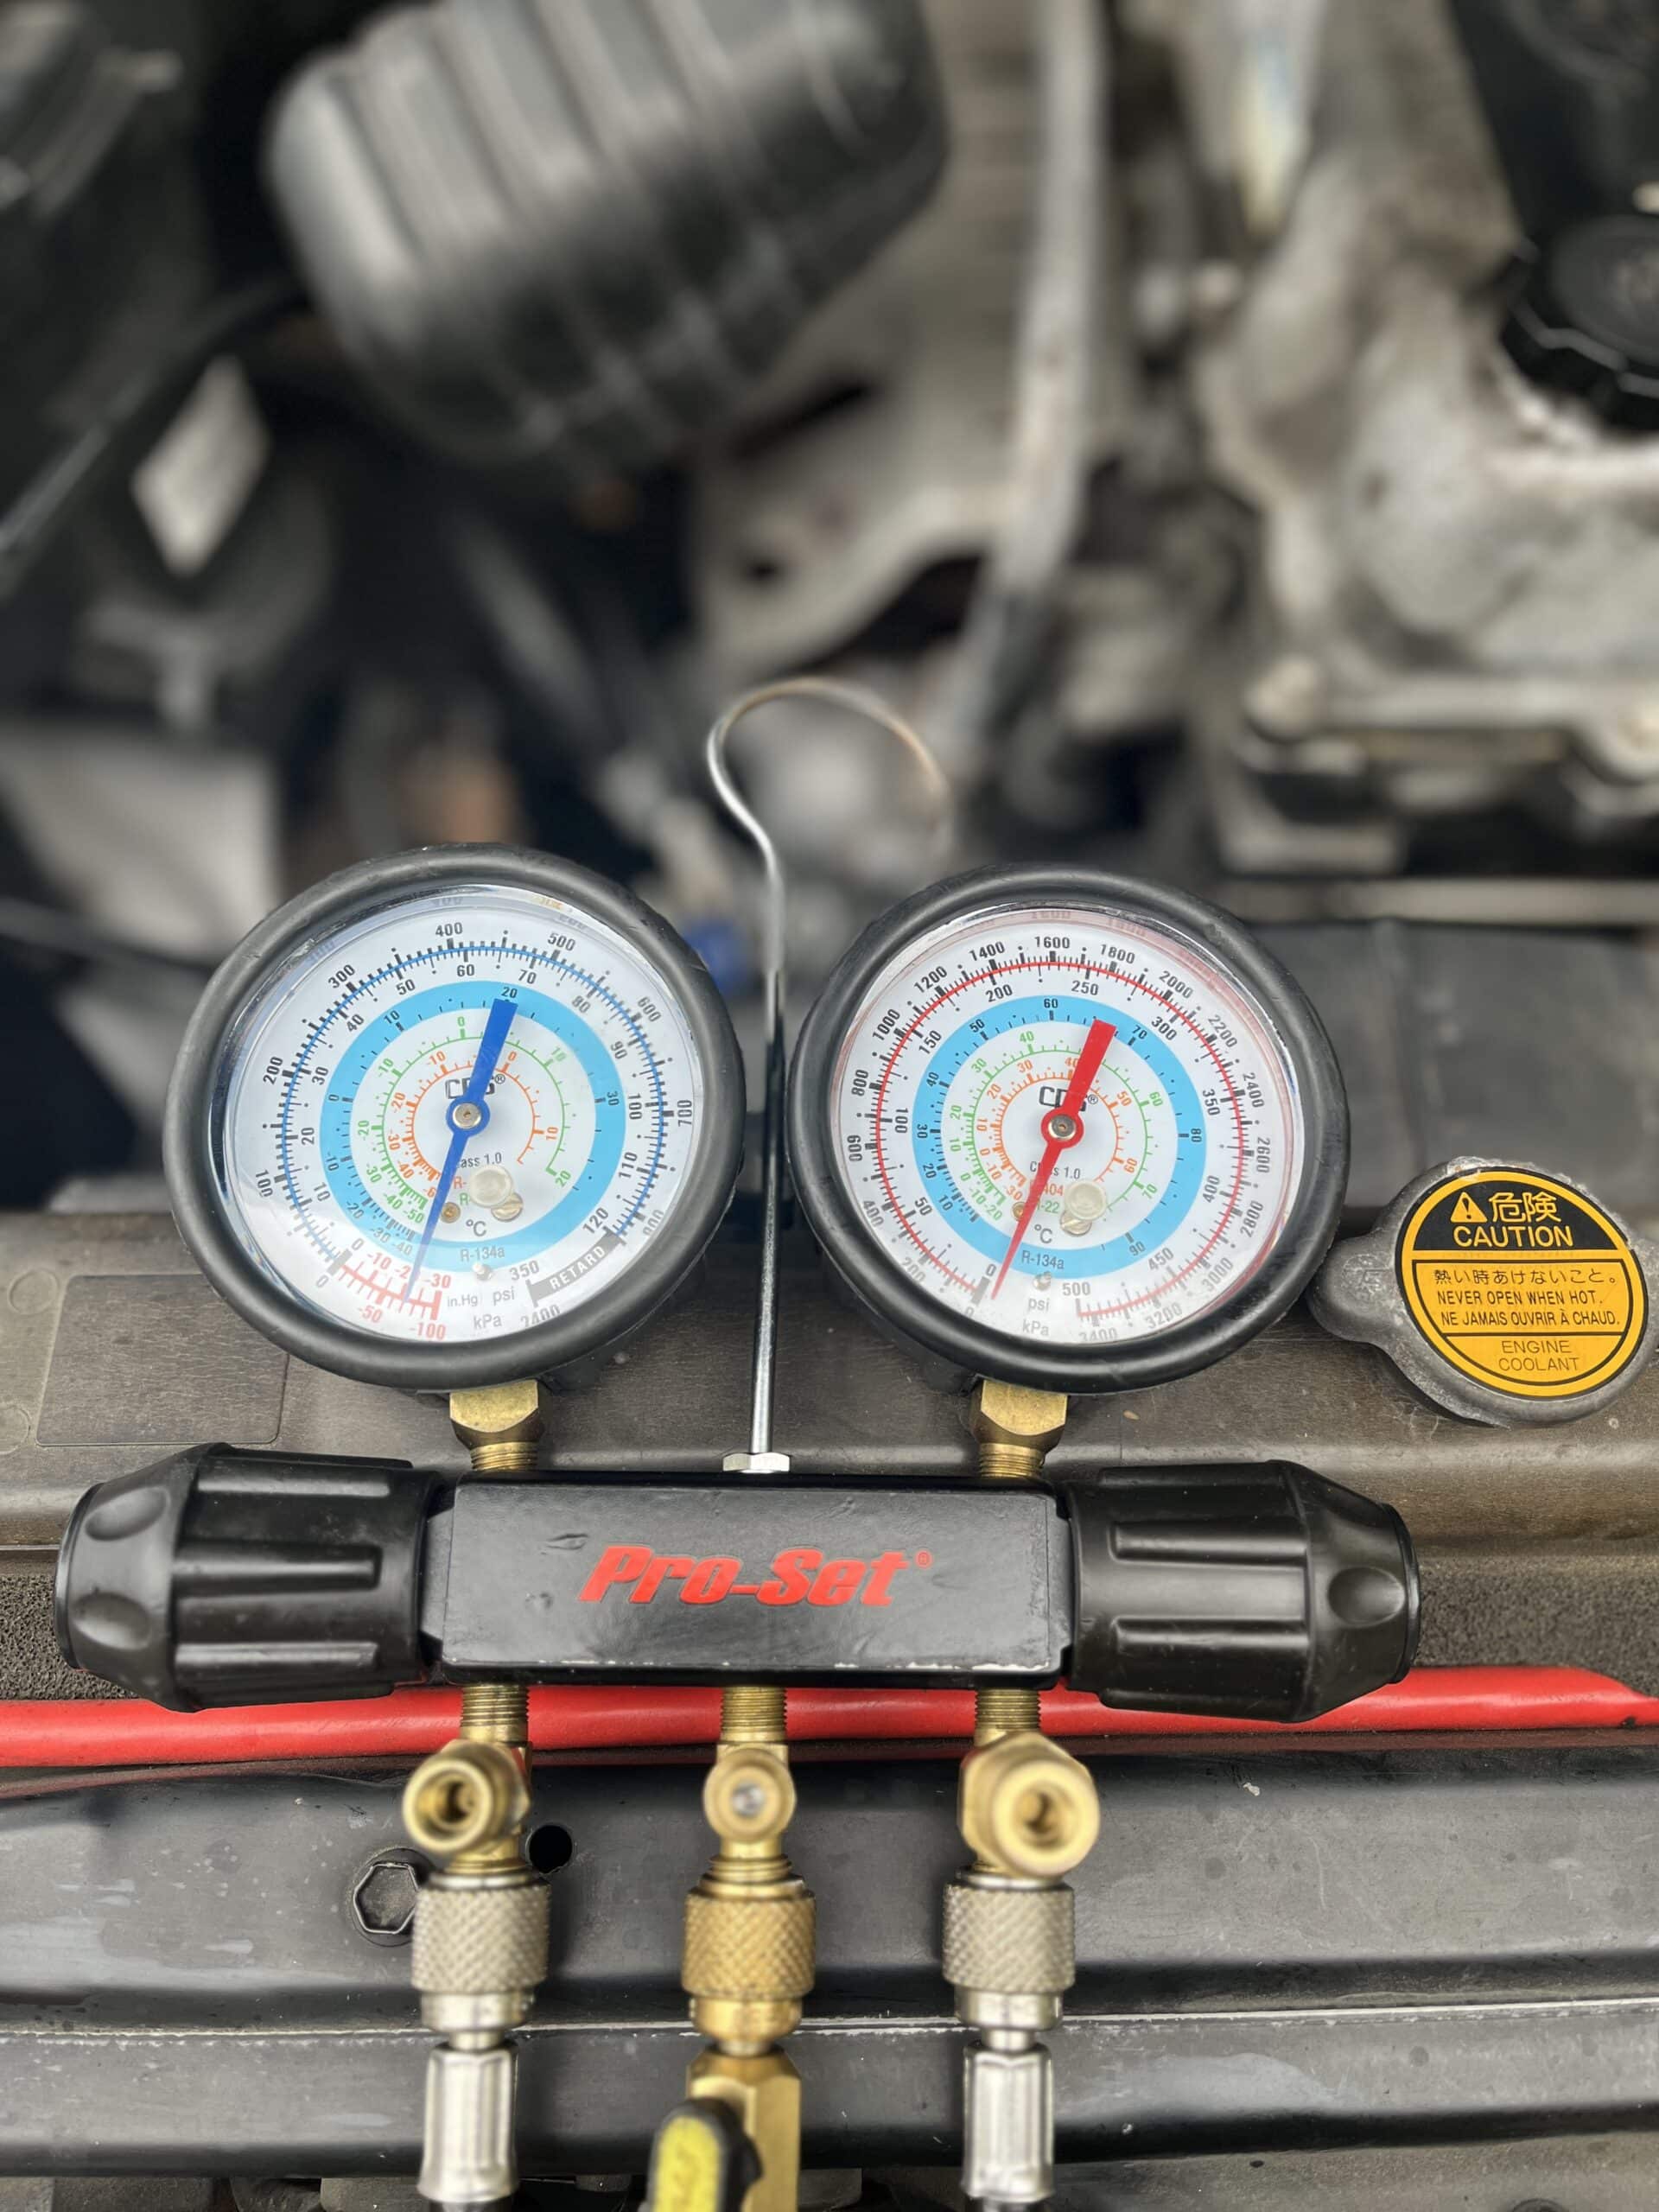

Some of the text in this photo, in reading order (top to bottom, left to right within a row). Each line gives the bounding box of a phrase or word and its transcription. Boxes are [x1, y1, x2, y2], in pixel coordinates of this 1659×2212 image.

[435, 922, 463, 937] 400
[547, 932, 575, 951] 500
[1033, 936, 1071, 950] 1600
[969, 941, 1006, 962] 1400
[1101, 944, 1135, 964] 1800
[327, 963, 356, 989] 300
[456, 963, 475, 977] 60
[518, 969, 537, 984] 70
[396, 979, 416, 995] 50
[913, 965, 948, 994] 1200
[1071, 980, 1098, 995] 250
[1159, 970, 1194, 999] 2000
[501, 987, 518, 998] 20
[985, 984, 1013, 1002] 200
[571, 996, 591, 1014] 80
[637, 996, 662, 1022] 600
[1043, 998, 1058, 1008] 60
[346, 1014, 365, 1033] 40
[385, 1009, 400, 1025] 10
[457, 1016, 465, 1027] 0
[872, 1008, 901, 1042] 1000
[969, 1019, 986, 1033] 50
[1132, 1026, 1147, 1040] 70
[1151, 1016, 1178, 1041] 300
[1208, 1015, 1237, 1048] 2200
[918, 1030, 942, 1055] 150
[1020, 1030, 1034, 1041] 40
[427, 1050, 447, 1067] -10
[507, 1051, 517, 1062] 0
[610, 1040, 627, 1060] 90
[263, 1056, 283, 1085] 200
[378, 1058, 394, 1077] -10
[971, 1058, 988, 1073] 30
[1017, 1059, 1033, 1072] 30
[311, 1066, 329, 1085] 30
[851, 1070, 869, 1096] 800
[925, 1071, 939, 1088] 40
[607, 1090, 620, 1106] 30
[987, 1084, 1001, 1100] 20
[1117, 1090, 1133, 1107] 50
[1149, 1091, 1164, 1107] 60
[1243, 1072, 1265, 1109] 2400
[391, 1092, 406, 1114] -20
[627, 1093, 642, 1120] 100
[1202, 1089, 1221, 1116] 350
[677, 1100, 692, 1128] 700
[894, 1107, 908, 1133] 100
[950, 1104, 962, 1120] 20
[358, 1120, 370, 1141] -20
[917, 1123, 928, 1139] 30
[976, 1118, 988, 1131] 10
[301, 1127, 315, 1146] 20
[389, 1130, 400, 1151] -30
[546, 1127, 558, 1141] 10
[1191, 1128, 1202, 1142] 80
[847, 1135, 863, 1162] 600
[949, 1138, 962, 1152] 10
[979, 1147, 990, 1156] 0
[327, 1152, 340, 1172] -10
[484, 1152, 502, 1165] 1.0
[1255, 1137, 1271, 1173] 2600
[397, 1160, 415, 1179] -40
[619, 1152, 638, 1179] 110
[923, 1163, 937, 1179] 20
[986, 1162, 1002, 1180] -10
[1064, 1166, 1081, 1179] 1.0
[1123, 1157, 1138, 1173] 60
[366, 1164, 382, 1184] -30
[555, 1171, 571, 1187] 20
[960, 1173, 971, 1181] 0
[255, 1169, 273, 1198] 100
[314, 1181, 331, 1202] 10
[1142, 1183, 1159, 1199] 70
[1203, 1175, 1221, 1203] 400
[384, 1193, 404, 1210] -40
[938, 1195, 954, 1211] 10
[969, 1187, 986, 1205] -10
[346, 1200, 365, 1219] -20
[864, 1200, 884, 1228] 400
[914, 1197, 933, 1216] 50
[1488, 1192, 1561, 1224] 危険
[403, 1210, 425, 1224] -50
[583, 1208, 608, 1234] 120
[1240, 1201, 1264, 1238] 2800
[352, 1238, 365, 1250] 0
[369, 1228, 388, 1243] -30
[1452, 1225, 1573, 1248] CAUTION
[391, 1242, 413, 1255] -40
[461, 1247, 505, 1262] R-134a
[1128, 1241, 1145, 1256] 90
[366, 1253, 391, 1270] -10
[550, 1246, 605, 1290] RETARD
[1021, 1250, 1065, 1270] R-134a
[1147, 1248, 1174, 1272] 450
[510, 1260, 540, 1281] 350
[901, 1256, 926, 1283] 200
[986, 1263, 997, 1276] 0
[1202, 1257, 1234, 1293] 3000
[1433, 1268, 1619, 1286] 熱い時あけないこと。
[315, 1274, 329, 1288] 0
[422, 1273, 452, 1288] -30
[1062, 1281, 1091, 1296] 500
[447, 1294, 478, 1307] in.Hg
[493, 1287, 516, 1305] psi
[1437, 1290, 1483, 1305] NEVER
[1486, 1290, 1523, 1305] OPEN
[1526, 1289, 1565, 1305] WHEN
[1028, 1298, 1050, 1313] psi
[359, 1306, 384, 1323] -50
[474, 1314, 502, 1330] kPa
[1145, 1302, 1183, 1330] 3200
[1440, 1307, 1620, 1326] NE JAMAIS OUVRIR À CHAUD.
[408, 1322, 446, 1340] -100
[1022, 1319, 1050, 1336] kPa
[1501, 1340, 1572, 1354] ENGINE
[1497, 1357, 1580, 1372] COOLANT
